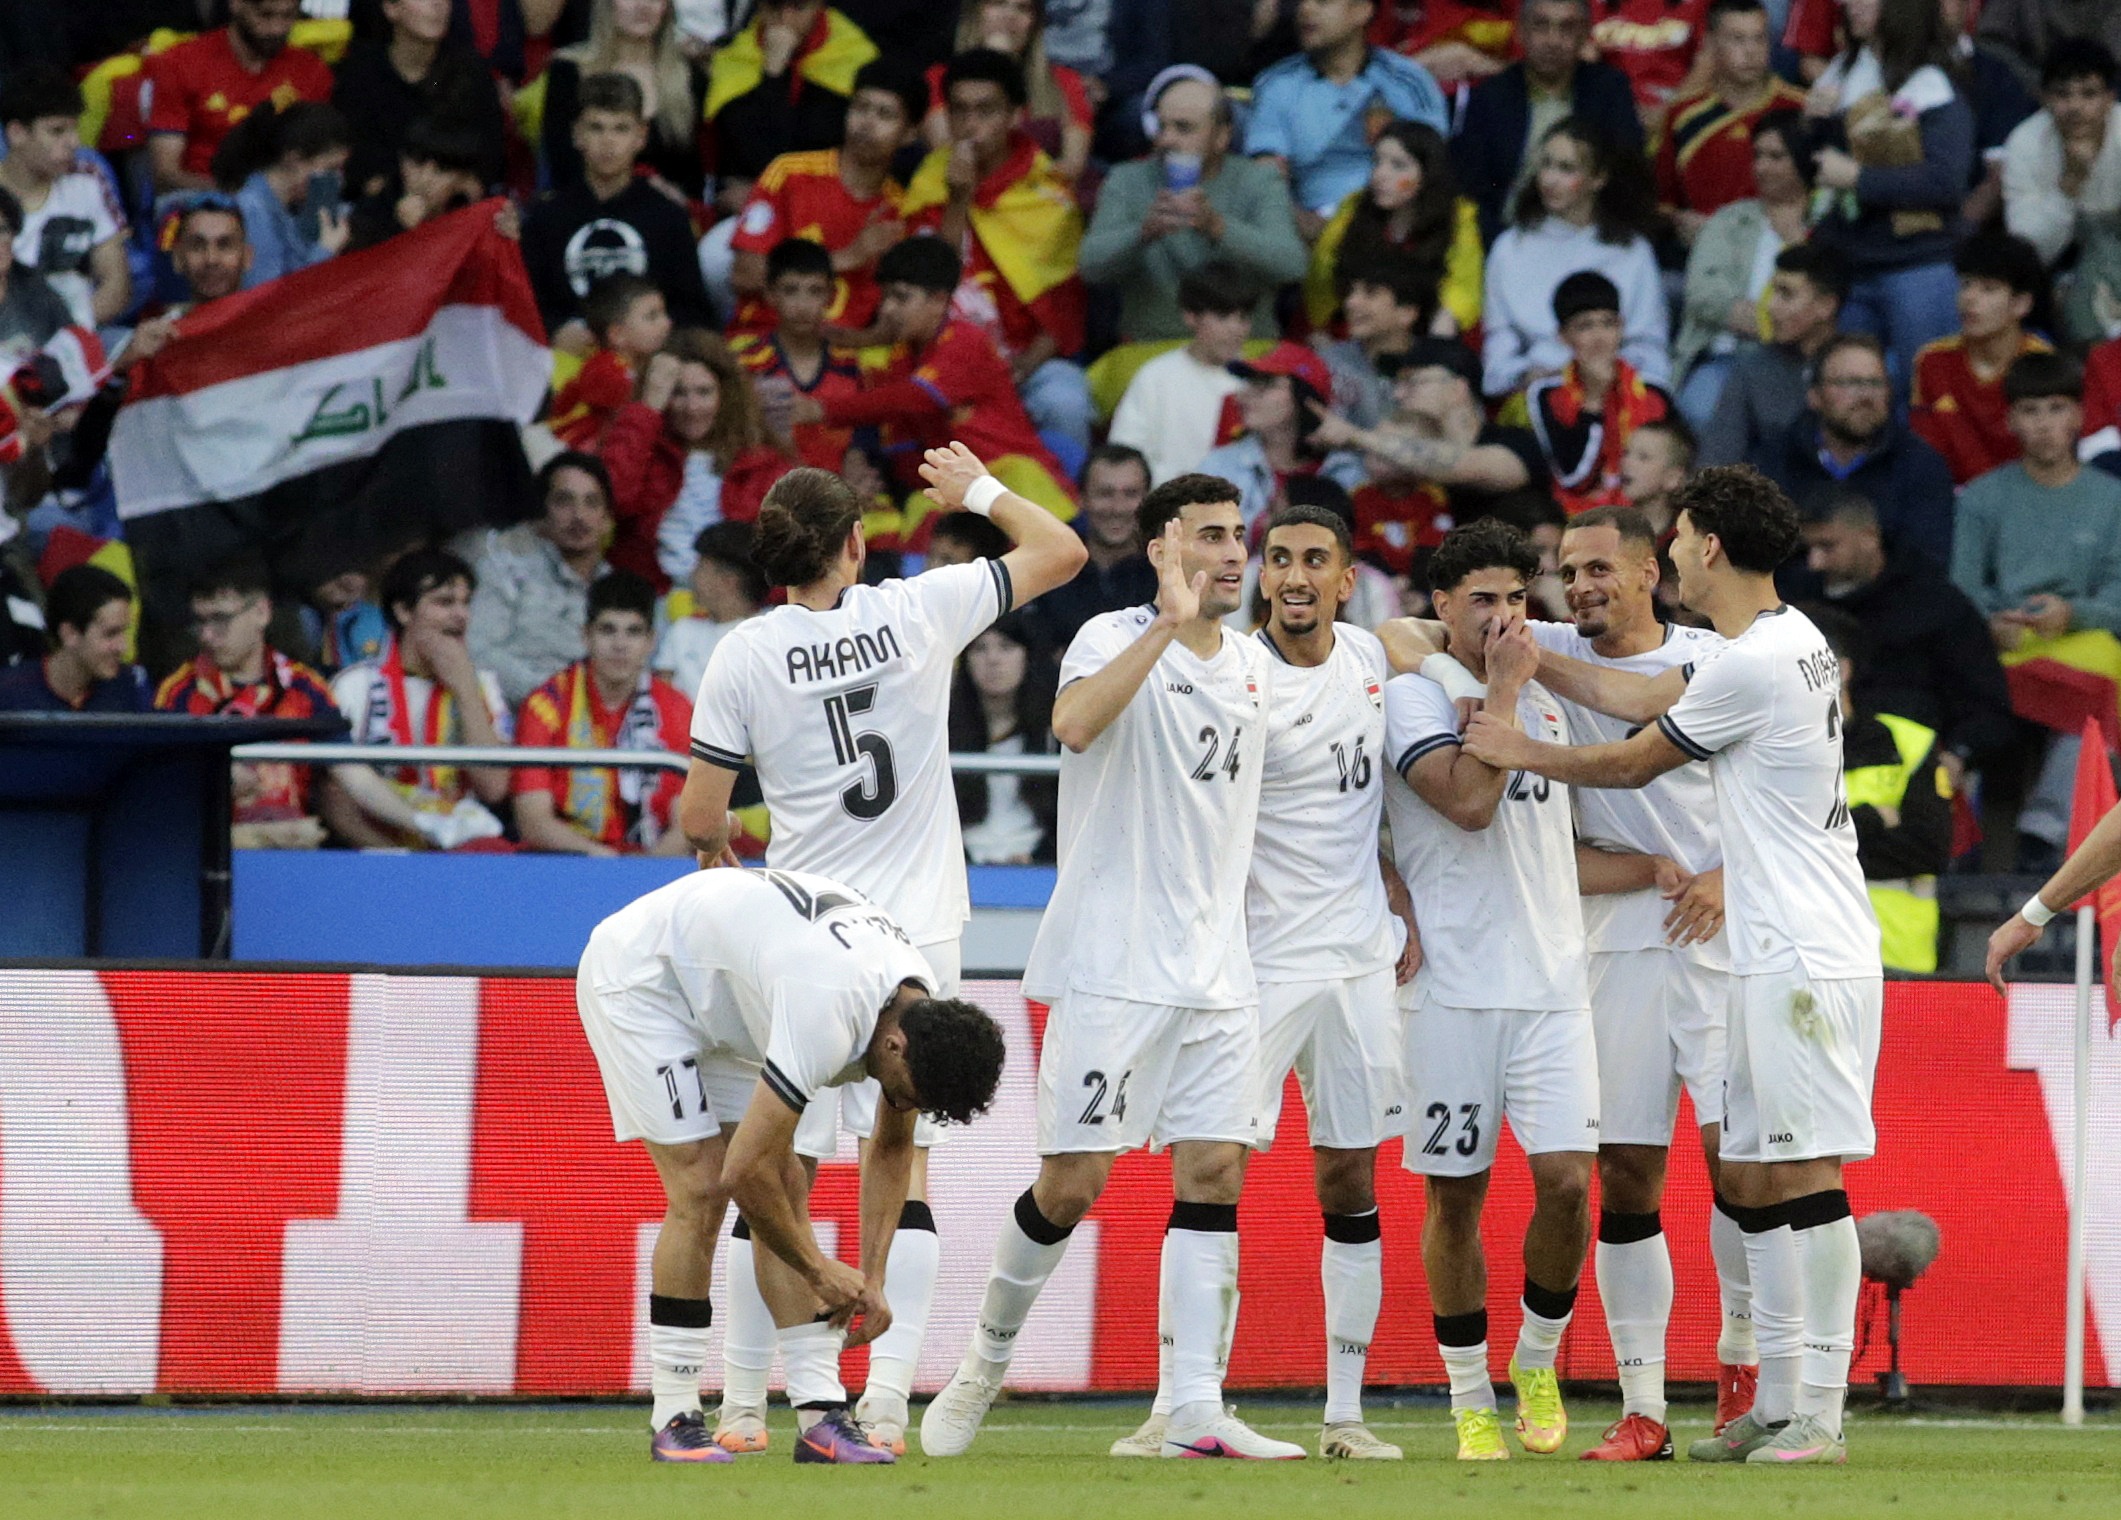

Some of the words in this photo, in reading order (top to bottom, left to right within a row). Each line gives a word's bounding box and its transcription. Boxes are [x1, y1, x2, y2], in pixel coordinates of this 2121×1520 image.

[786, 624, 902, 684] AKAM
[823, 682, 899, 822] 5
[1190, 725, 1242, 782] 24
[1328, 734, 1371, 793] 16
[656, 1058, 709, 1120] 17
[1078, 1069, 1131, 1125] 24
[1422, 1101, 1482, 1157] 23
[1768, 1132, 1794, 1144] JAKO
